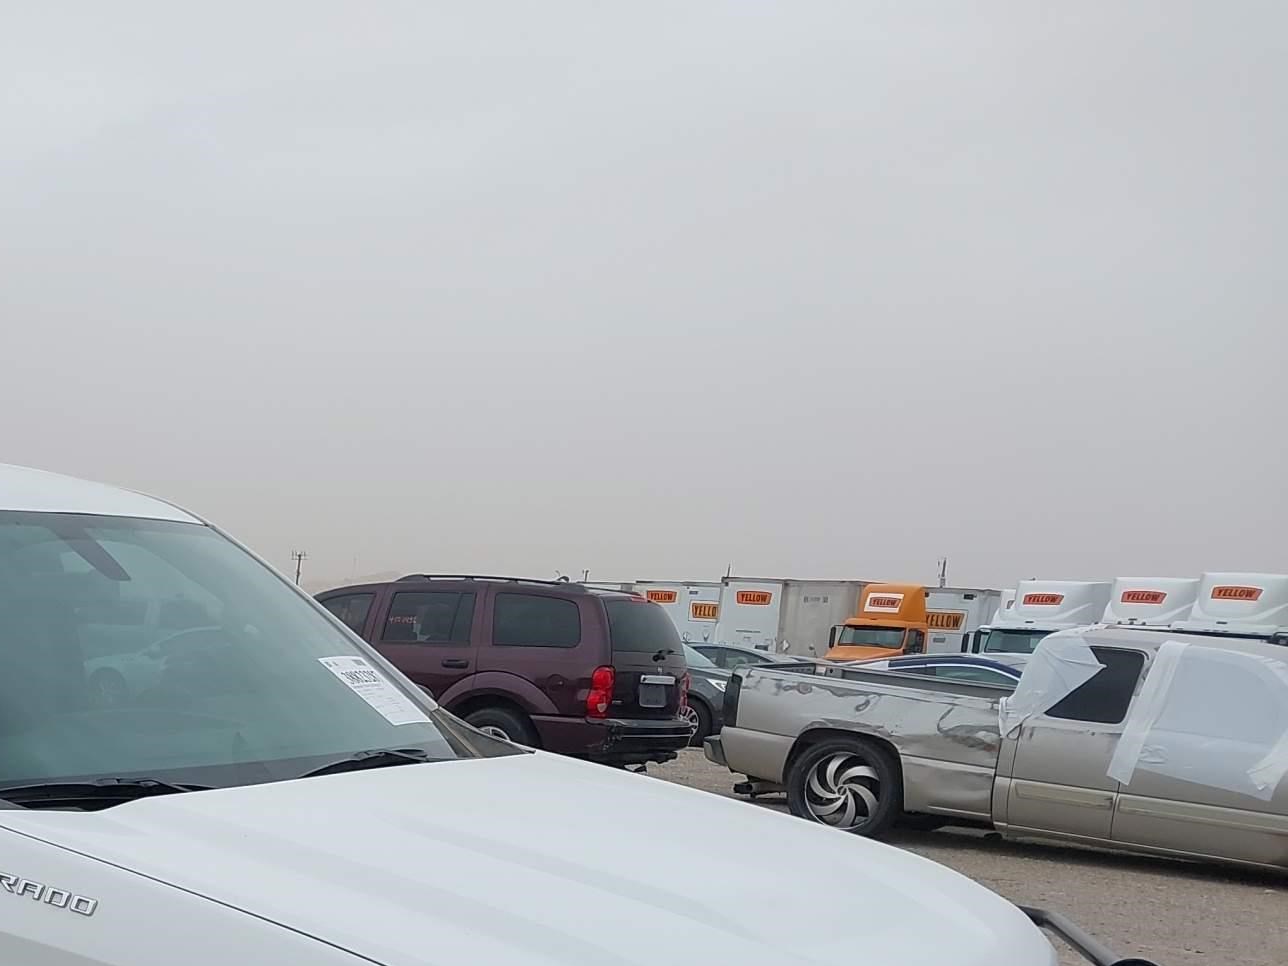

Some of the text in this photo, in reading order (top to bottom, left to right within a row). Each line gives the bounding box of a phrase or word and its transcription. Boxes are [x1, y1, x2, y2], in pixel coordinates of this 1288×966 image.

[649, 591, 674, 601] YELLOW
[740, 592, 768, 603] YELLOW
[1125, 592, 1160, 602] YELLOW
[1216, 588, 1257, 598] YELLOW
[872, 598, 898, 607] YELLOW
[1027, 595, 1059, 604] YELLOW
[693, 604, 718, 618] YELLO
[925, 613, 962, 628] YELLOW
